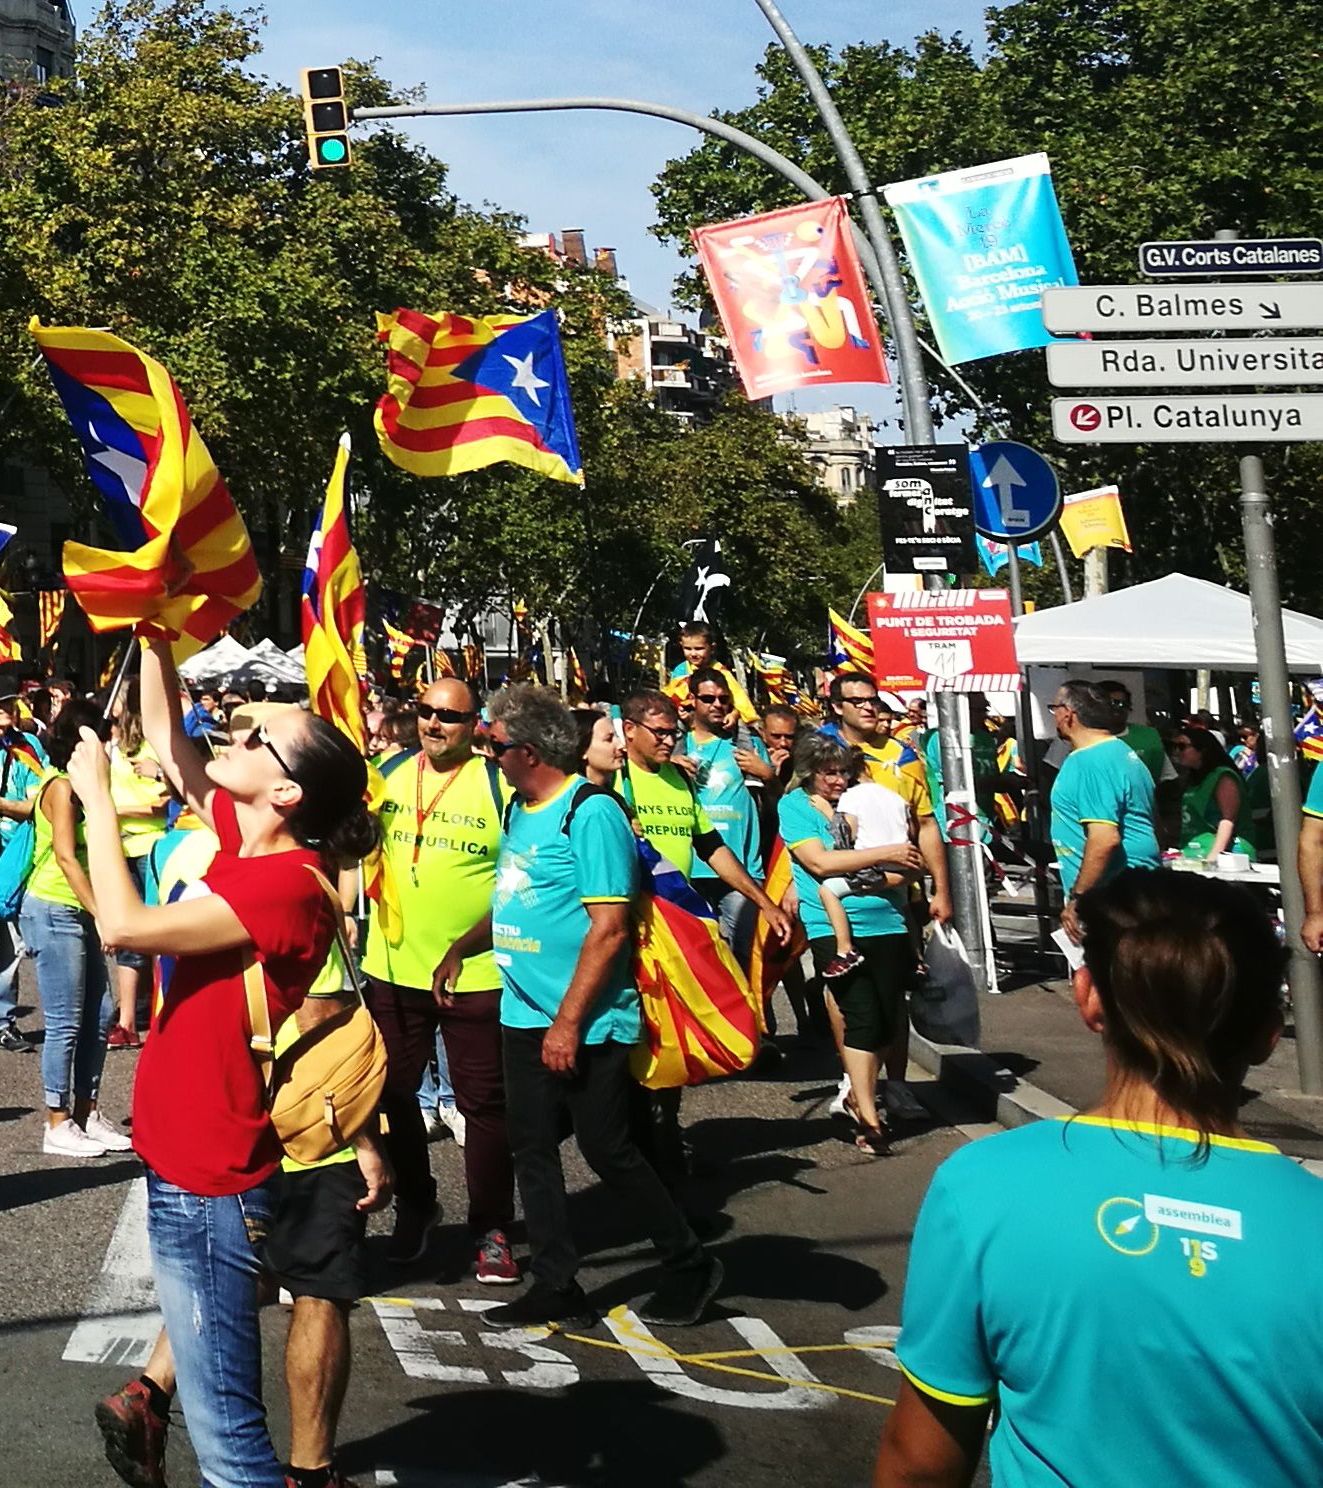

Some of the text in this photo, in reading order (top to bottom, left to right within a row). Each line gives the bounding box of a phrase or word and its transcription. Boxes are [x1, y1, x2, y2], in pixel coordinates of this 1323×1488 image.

[1146, 245, 1320, 267] G.V. Corts Catalanes
[1096, 293, 1243, 317] C. Balmes
[1101, 346, 1323, 372] Rda. Universita
[1106, 404, 1302, 431] Pl. Catalunya
[895, 479, 922, 488] som
[875, 614, 1005, 628] PUNT DE TROBADA
[904, 626, 979, 638] I SEGURETAT
[928, 642, 957, 650] TRAM
[432, 811, 487, 829] FLORS
[1158, 1205, 1231, 1227] assemblea
